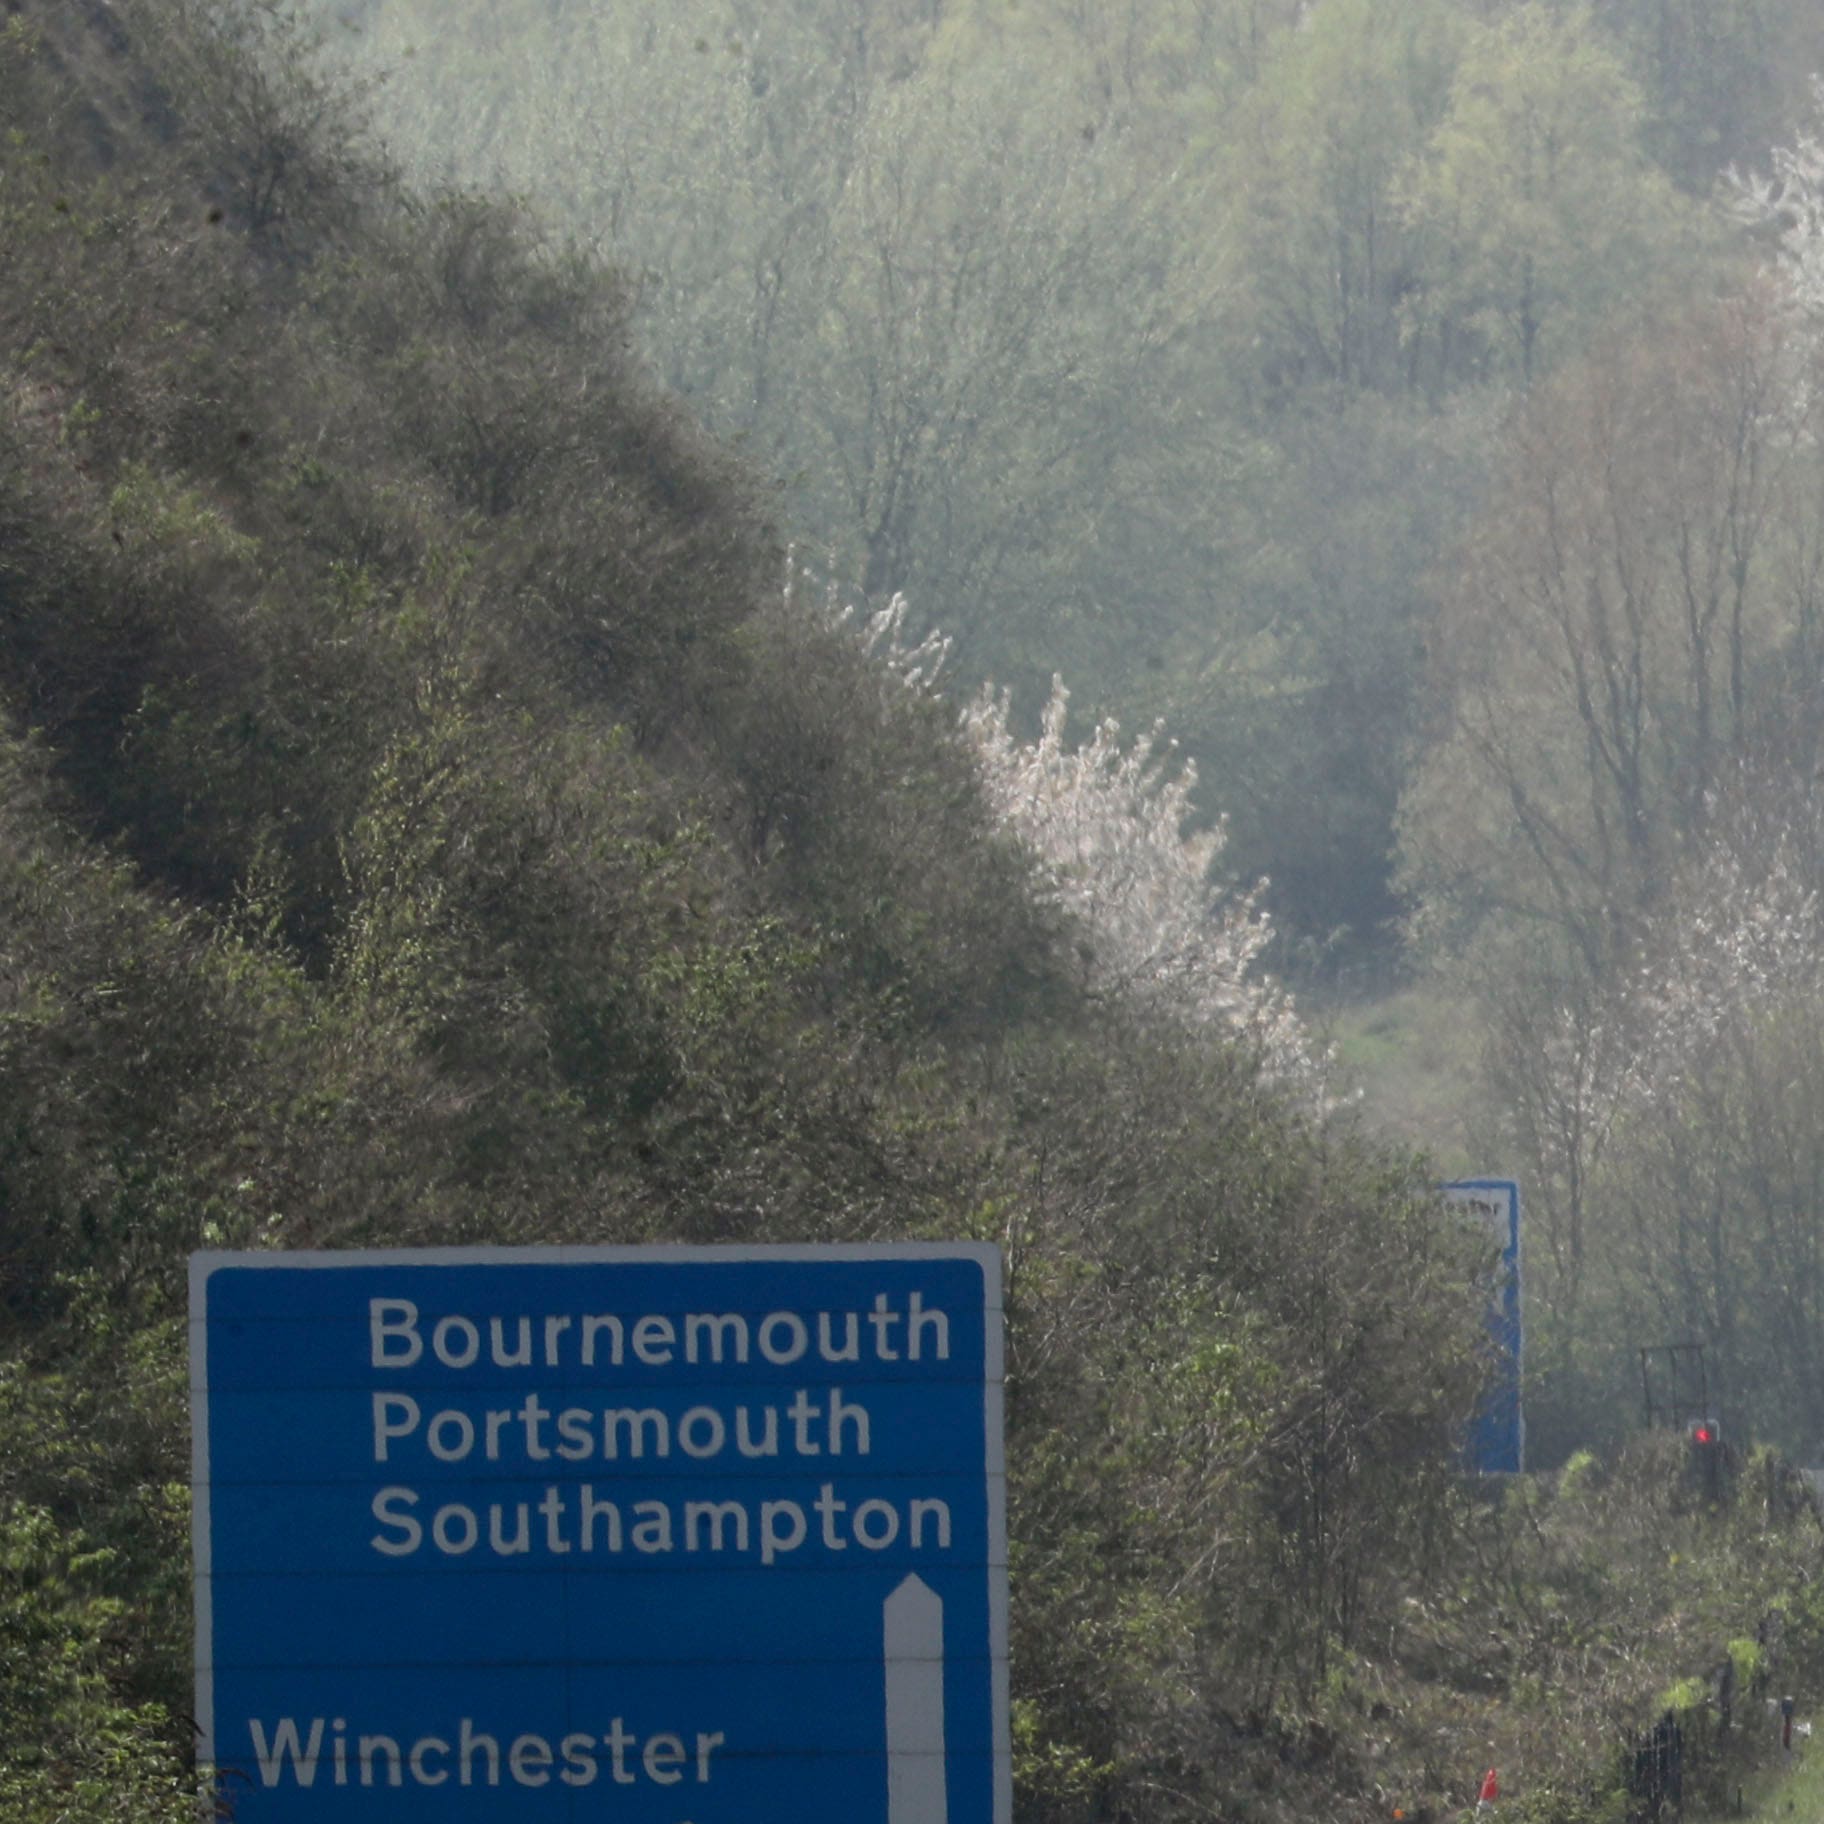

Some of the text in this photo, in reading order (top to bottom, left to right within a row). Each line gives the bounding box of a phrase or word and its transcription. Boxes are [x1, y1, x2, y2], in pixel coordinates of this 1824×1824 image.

[368, 1291, 952, 1370] Bournemouth
[371, 1389, 873, 1462] Portsmouth
[369, 1483, 953, 1565] Southampton
[248, 1716, 726, 1789] Winchester
